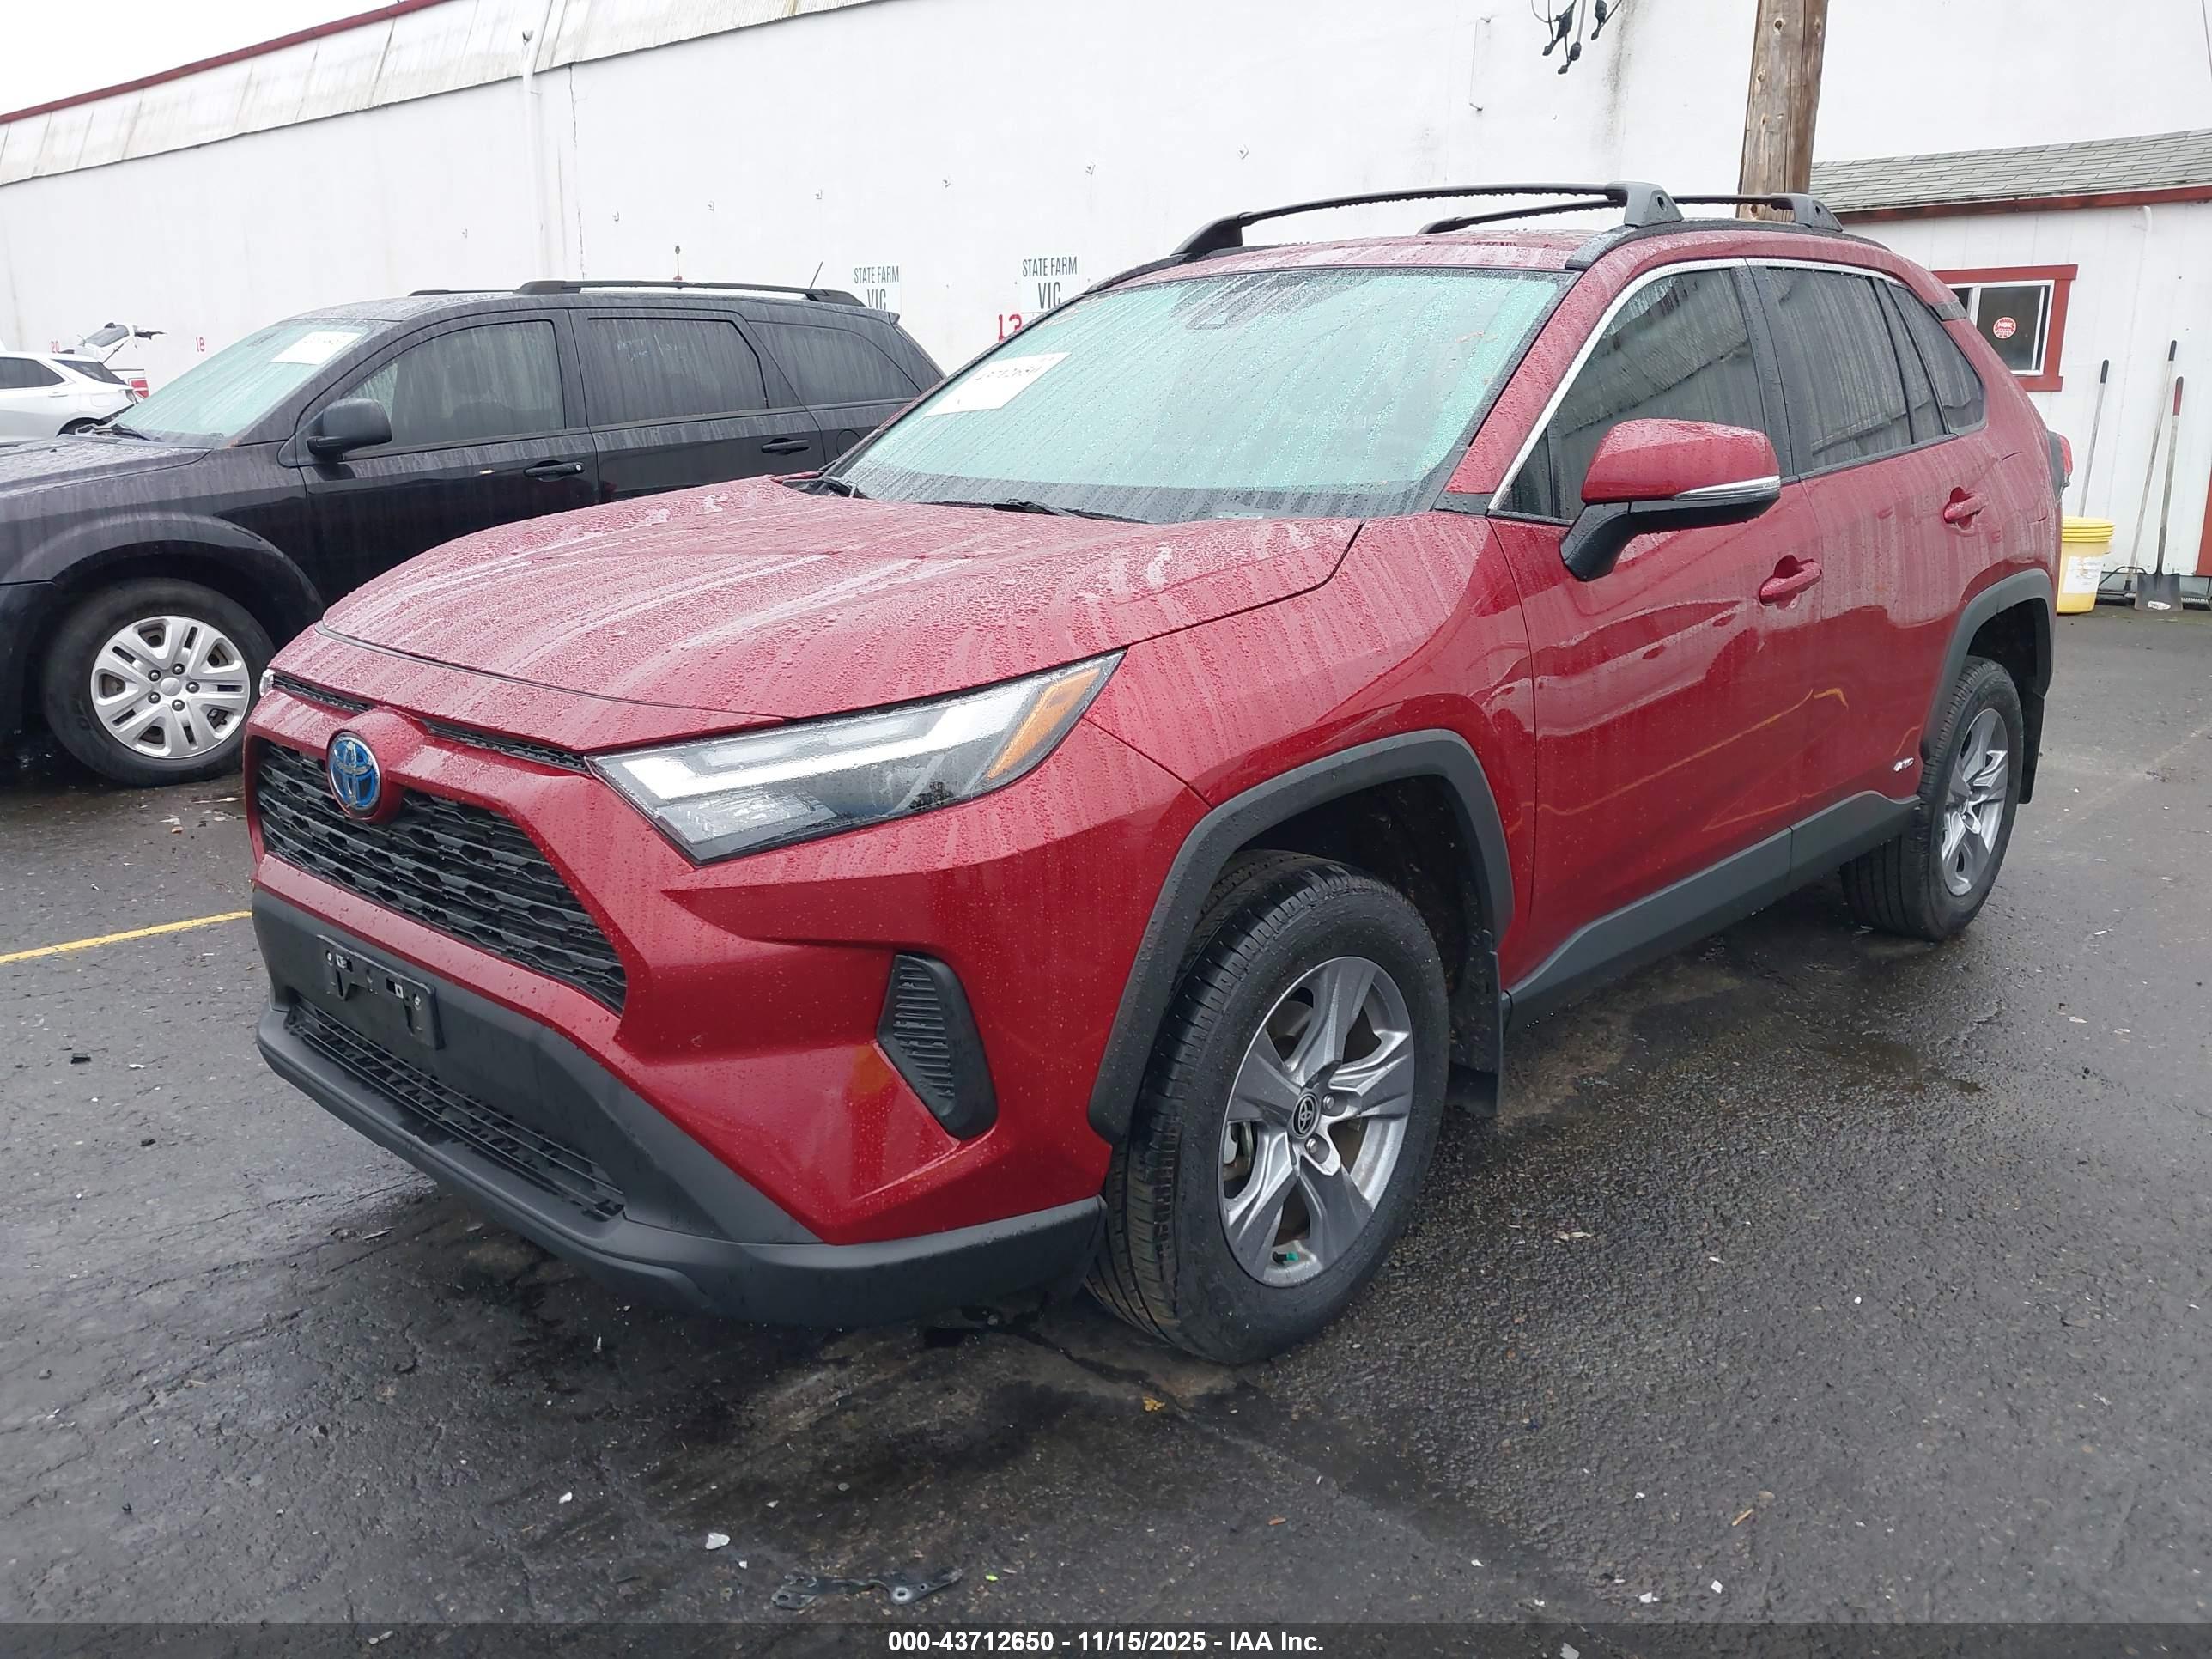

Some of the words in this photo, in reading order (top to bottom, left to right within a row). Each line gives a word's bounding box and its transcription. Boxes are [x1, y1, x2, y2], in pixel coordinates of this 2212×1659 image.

[854, 267, 875, 284] STATE
[877, 265, 899, 283] FARM
[1022, 258, 1048, 277] STATE
[1050, 256, 1078, 276] FARM
[866, 289, 886, 310] VIC
[1037, 281, 1061, 309] VIC
[195, 336, 205, 352] 18
